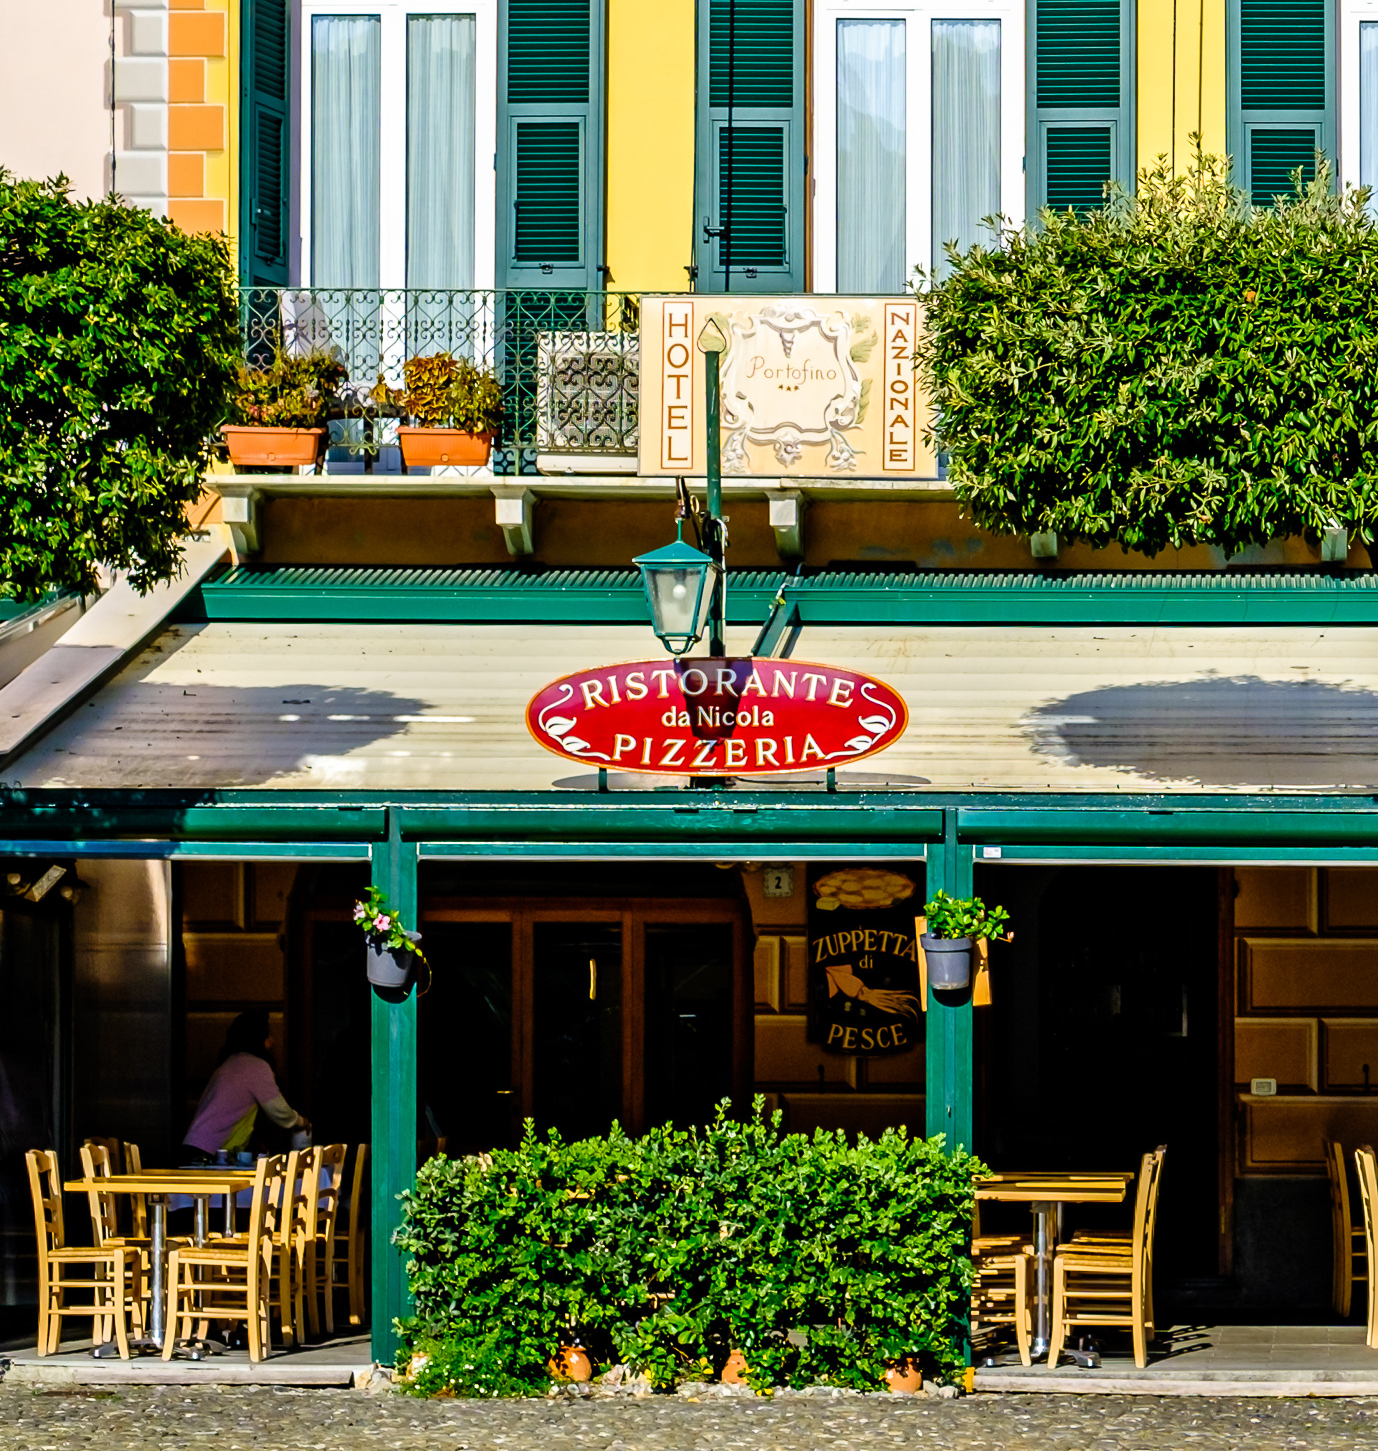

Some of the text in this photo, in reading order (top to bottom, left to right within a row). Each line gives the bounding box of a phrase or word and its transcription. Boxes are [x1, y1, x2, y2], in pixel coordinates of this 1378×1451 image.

[667, 312, 690, 462] HOTEL
[746, 355, 838, 386] Portofino
[889, 311, 910, 463] NAZIONALE
[579, 667, 856, 711] RISTORANTE
[661, 705, 775, 728] da Nicola
[610, 733, 827, 768] PIZZERIA
[774, 876, 782, 890] 2
[812, 929, 917, 964] ZUPPETTA
[859, 954, 874, 969] di
[826, 1023, 908, 1050] PESCE
